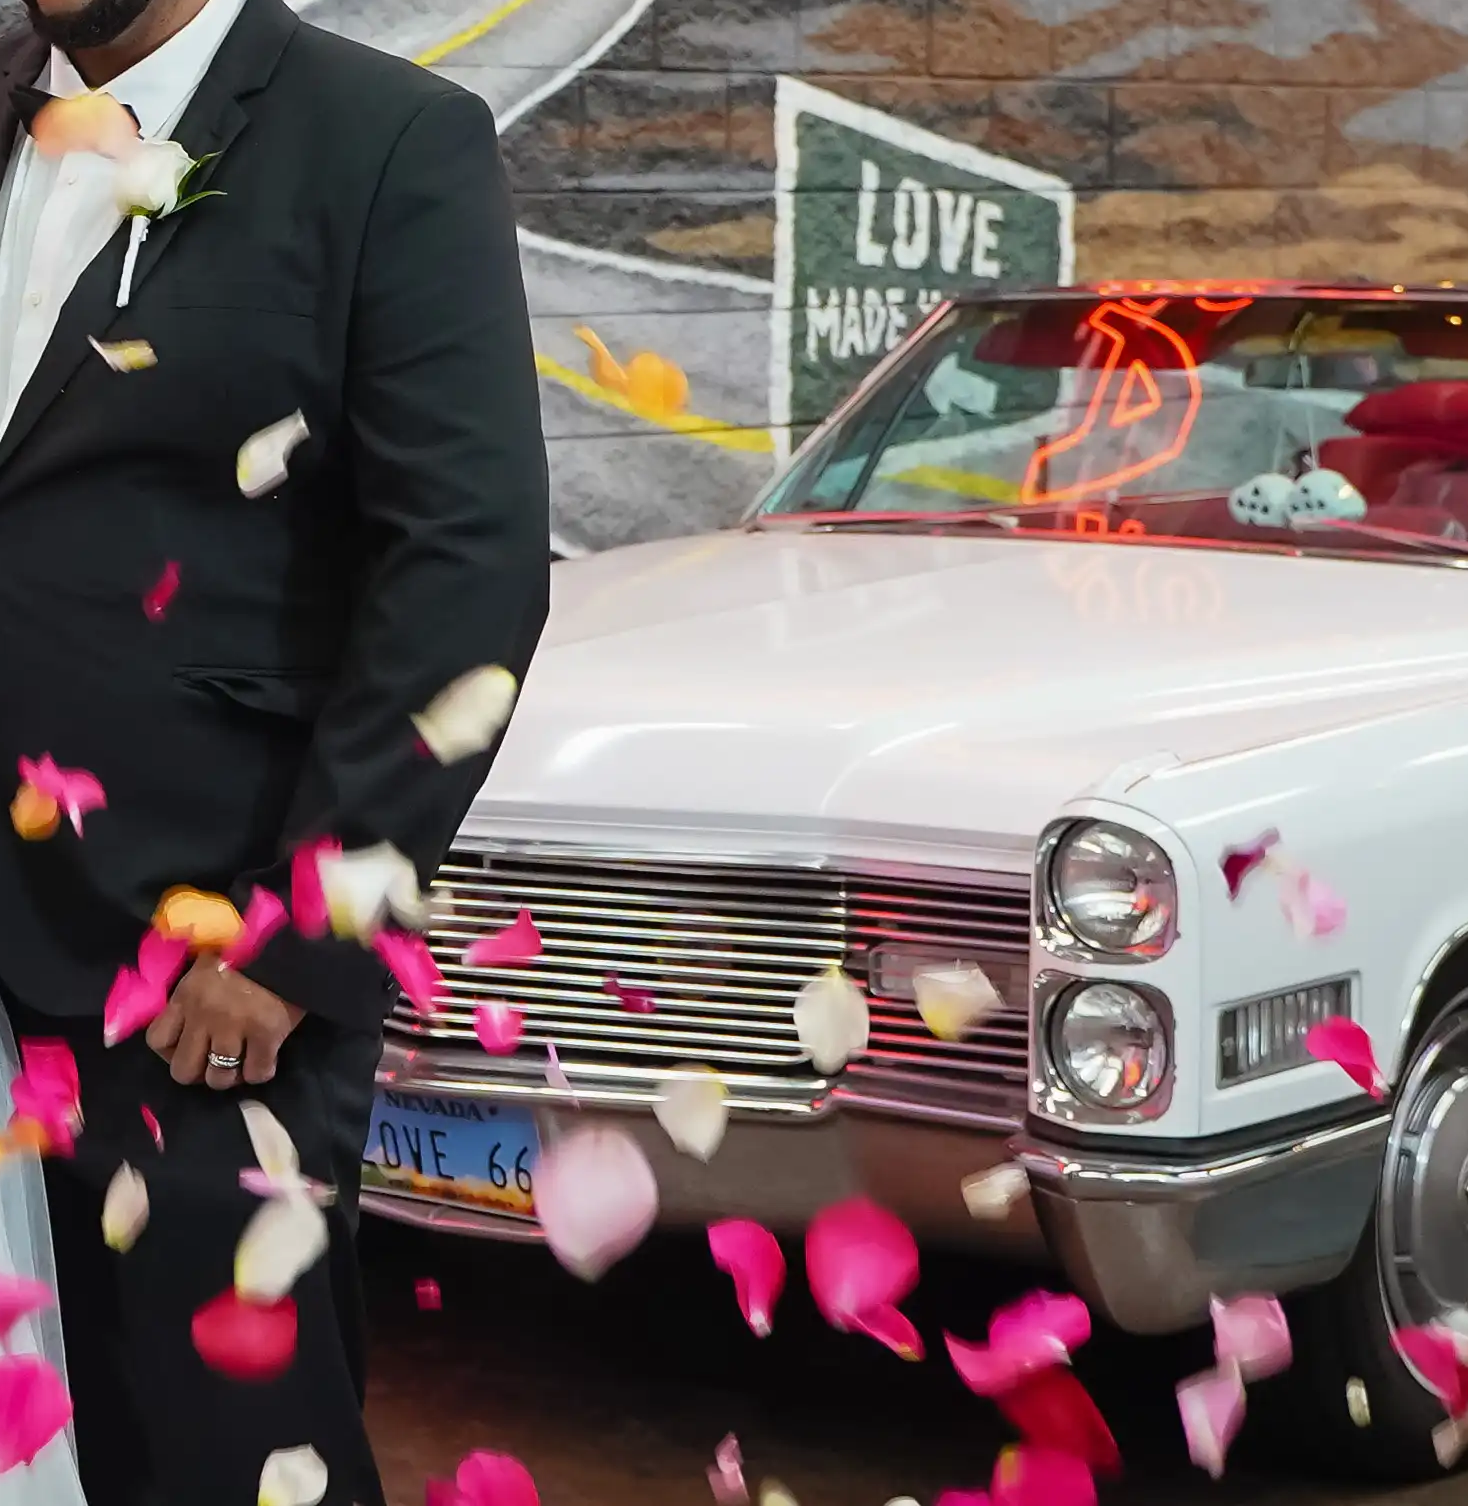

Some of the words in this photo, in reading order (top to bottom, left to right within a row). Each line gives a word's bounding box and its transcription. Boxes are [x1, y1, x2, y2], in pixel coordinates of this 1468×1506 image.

[855, 159, 1007, 278] LOVE
[806, 286, 908, 362] MADE
[383, 1089, 486, 1123] NEVADA
[487, 1141, 533, 1194] 66
